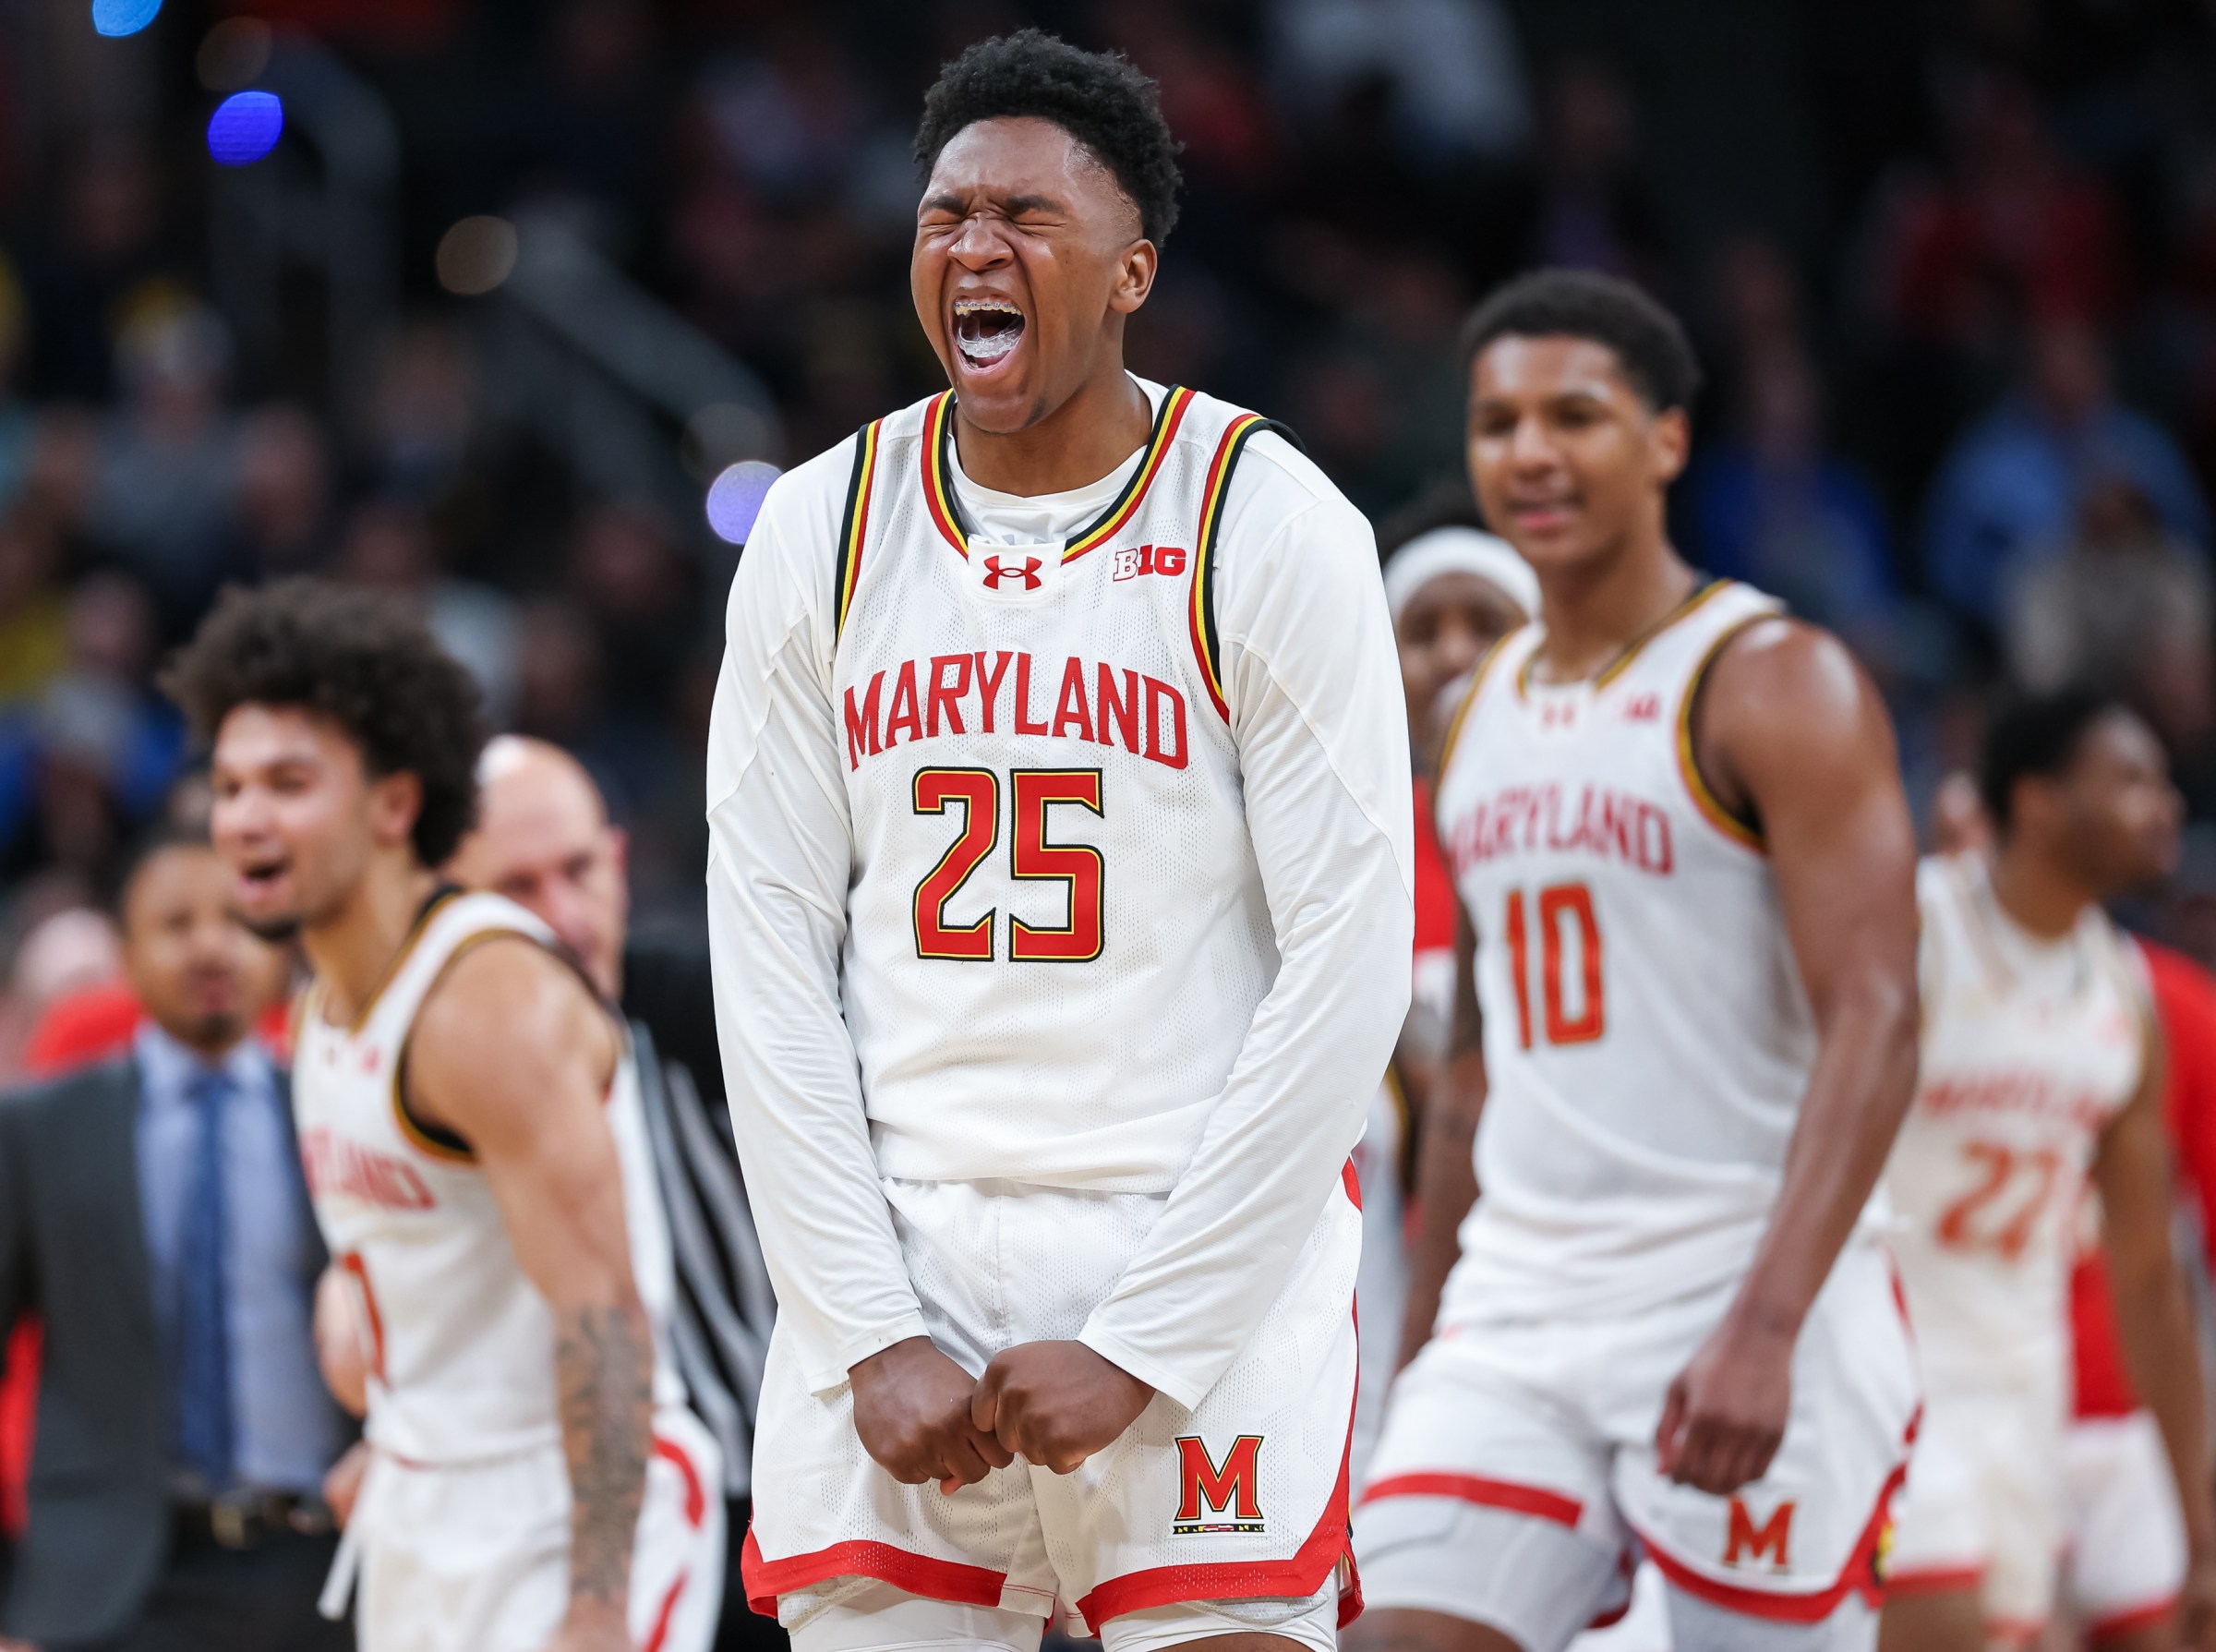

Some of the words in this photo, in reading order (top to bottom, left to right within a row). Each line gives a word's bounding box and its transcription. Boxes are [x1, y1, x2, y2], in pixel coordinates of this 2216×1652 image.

[844, 650, 1189, 772] MARYLAND
[912, 766, 1105, 962] 25
[1506, 881, 1605, 1050] 10
[1174, 1434, 1265, 1522] M
[1724, 1493, 1797, 1573] M
